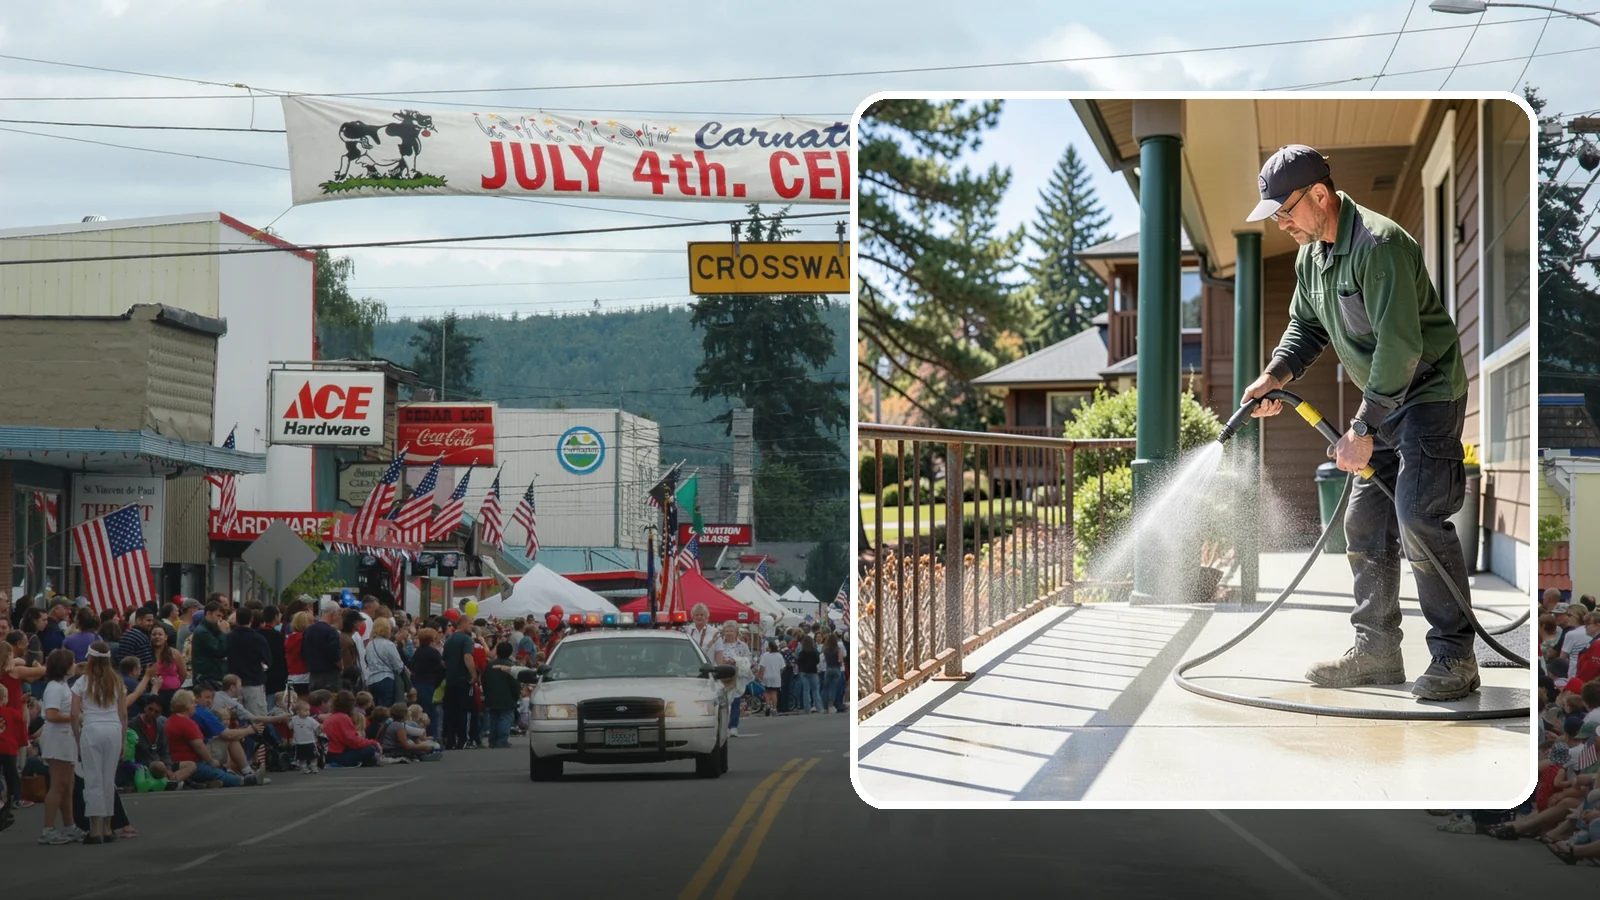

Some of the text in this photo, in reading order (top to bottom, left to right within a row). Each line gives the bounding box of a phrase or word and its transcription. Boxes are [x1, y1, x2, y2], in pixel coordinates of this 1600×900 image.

[695, 121, 850, 150] Carnat
[481, 141, 604, 192] JULY
[632, 150, 746, 198] 4th.
[697, 255, 850, 280] CROSSWA
[283, 380, 373, 419] ACE
[406, 409, 485, 421] CEDAR LOG
[283, 421, 370, 436] Hardware
[353, 467, 387, 480] Simpl
[95, 485, 124, 495] Vincent
[126, 486, 136, 494] de
[138, 486, 155, 495] Paul
[688, 526, 741, 535] CRNATION
[699, 535, 730, 543] GLASS
